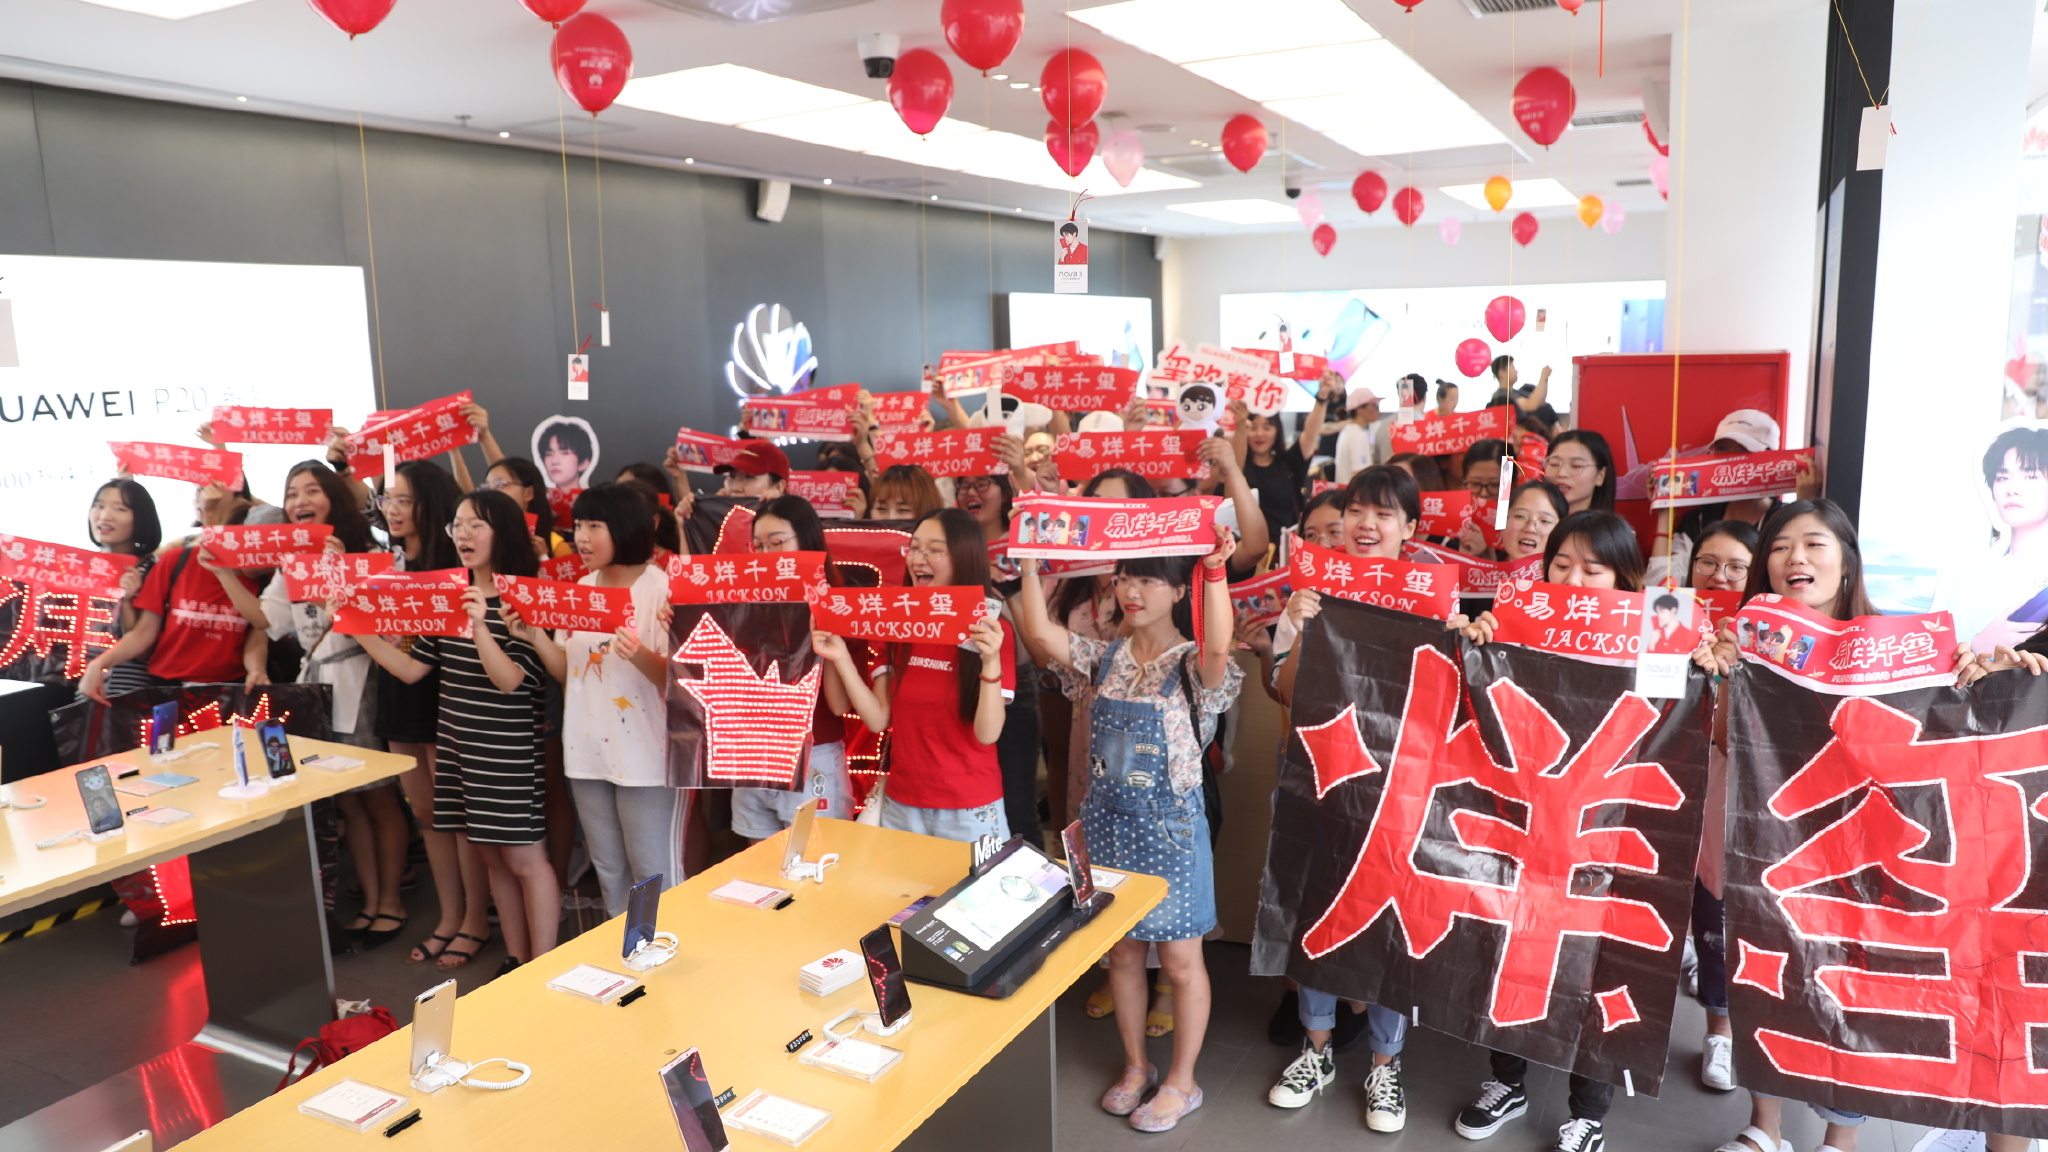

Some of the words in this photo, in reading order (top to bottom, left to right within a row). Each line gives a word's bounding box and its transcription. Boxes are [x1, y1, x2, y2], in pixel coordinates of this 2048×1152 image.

[1019, 370, 1117, 392] 易烊千玺
[155, 386, 208, 413] P20
[1032, 394, 1106, 409] JACKSON
[228, 410, 314, 429] 易烊千玺
[1402, 411, 1498, 442] 易烊千玺
[242, 430, 306, 443] JACKSON
[366, 413, 459, 456] 易烊千玺
[393, 432, 453, 461] ACKSON
[890, 432, 985, 459] 易烊千玺
[1076, 433, 1185, 459] 易烊千玺
[1103, 508, 1201, 539] 易烊千玺
[221, 528, 313, 550] 易烊千玺
[2, 541, 112, 578] 易烊千玺
[236, 551, 307, 567] JACKS
[689, 556, 801, 586] 易烊千玺
[13, 564, 101, 589] JACKSON
[1299, 551, 1436, 597] 易烊千玺
[356, 593, 455, 615] 易烊千玺
[514, 583, 611, 614] 易烊千玺
[706, 586, 790, 602] JACKSON
[828, 592, 957, 617] 易烊千玺
[1308, 585, 1417, 611] ACKSON
[531, 609, 602, 630] JACKSON
[1523, 591, 1642, 627] 易烊千
[375, 618, 446, 633] JACKSON
[850, 621, 945, 639] JACKSON
[1540, 628, 1642, 655] JACKSO
[1296, 644, 1686, 1027] 烊
